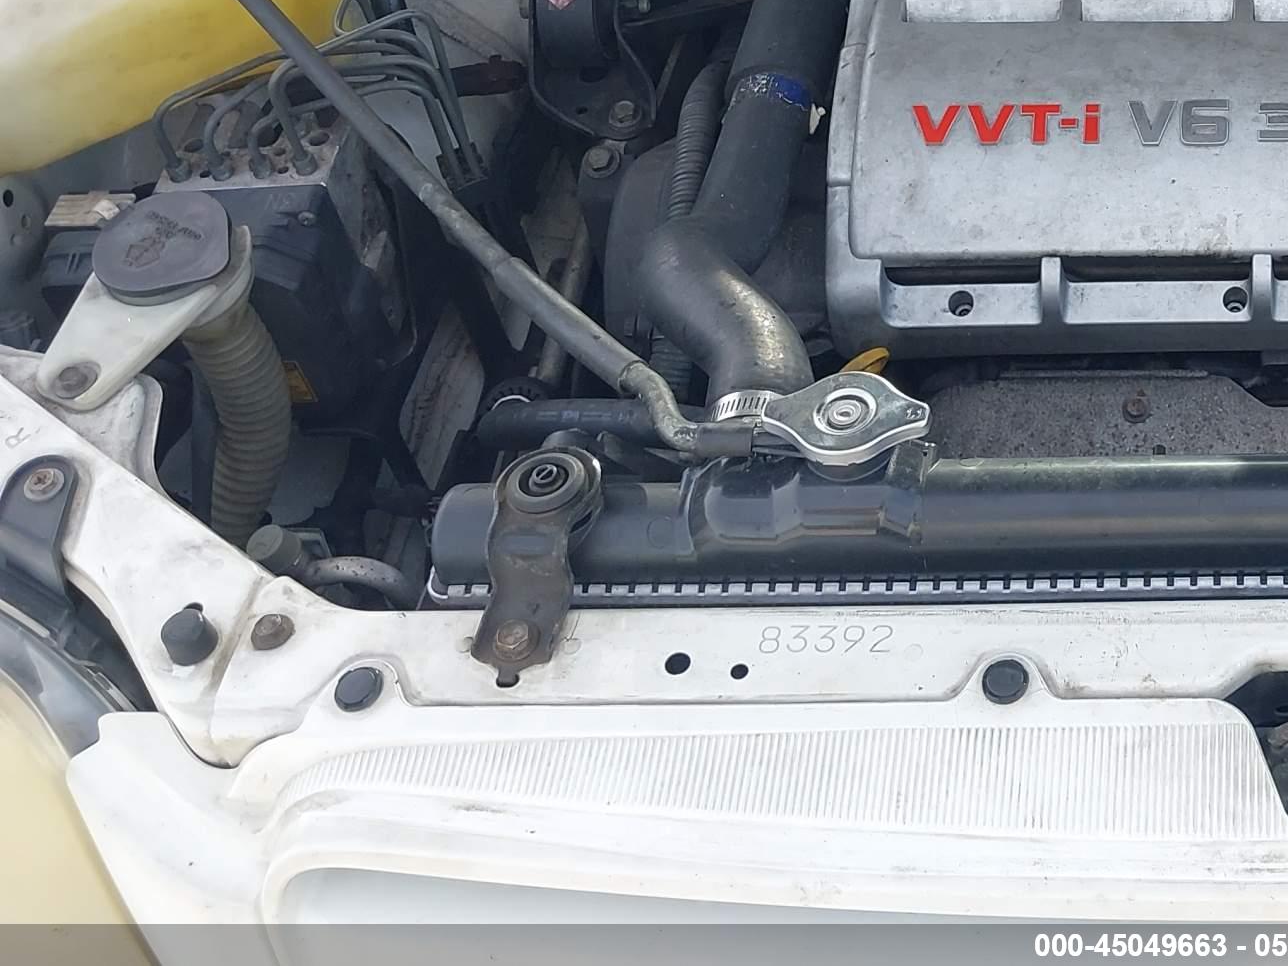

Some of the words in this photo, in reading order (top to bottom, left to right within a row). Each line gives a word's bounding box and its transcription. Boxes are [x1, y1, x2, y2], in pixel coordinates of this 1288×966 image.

[911, 103, 1101, 146] VVT-i
[1127, 98, 1230, 147] V6
[758, 625, 894, 654] 83392
